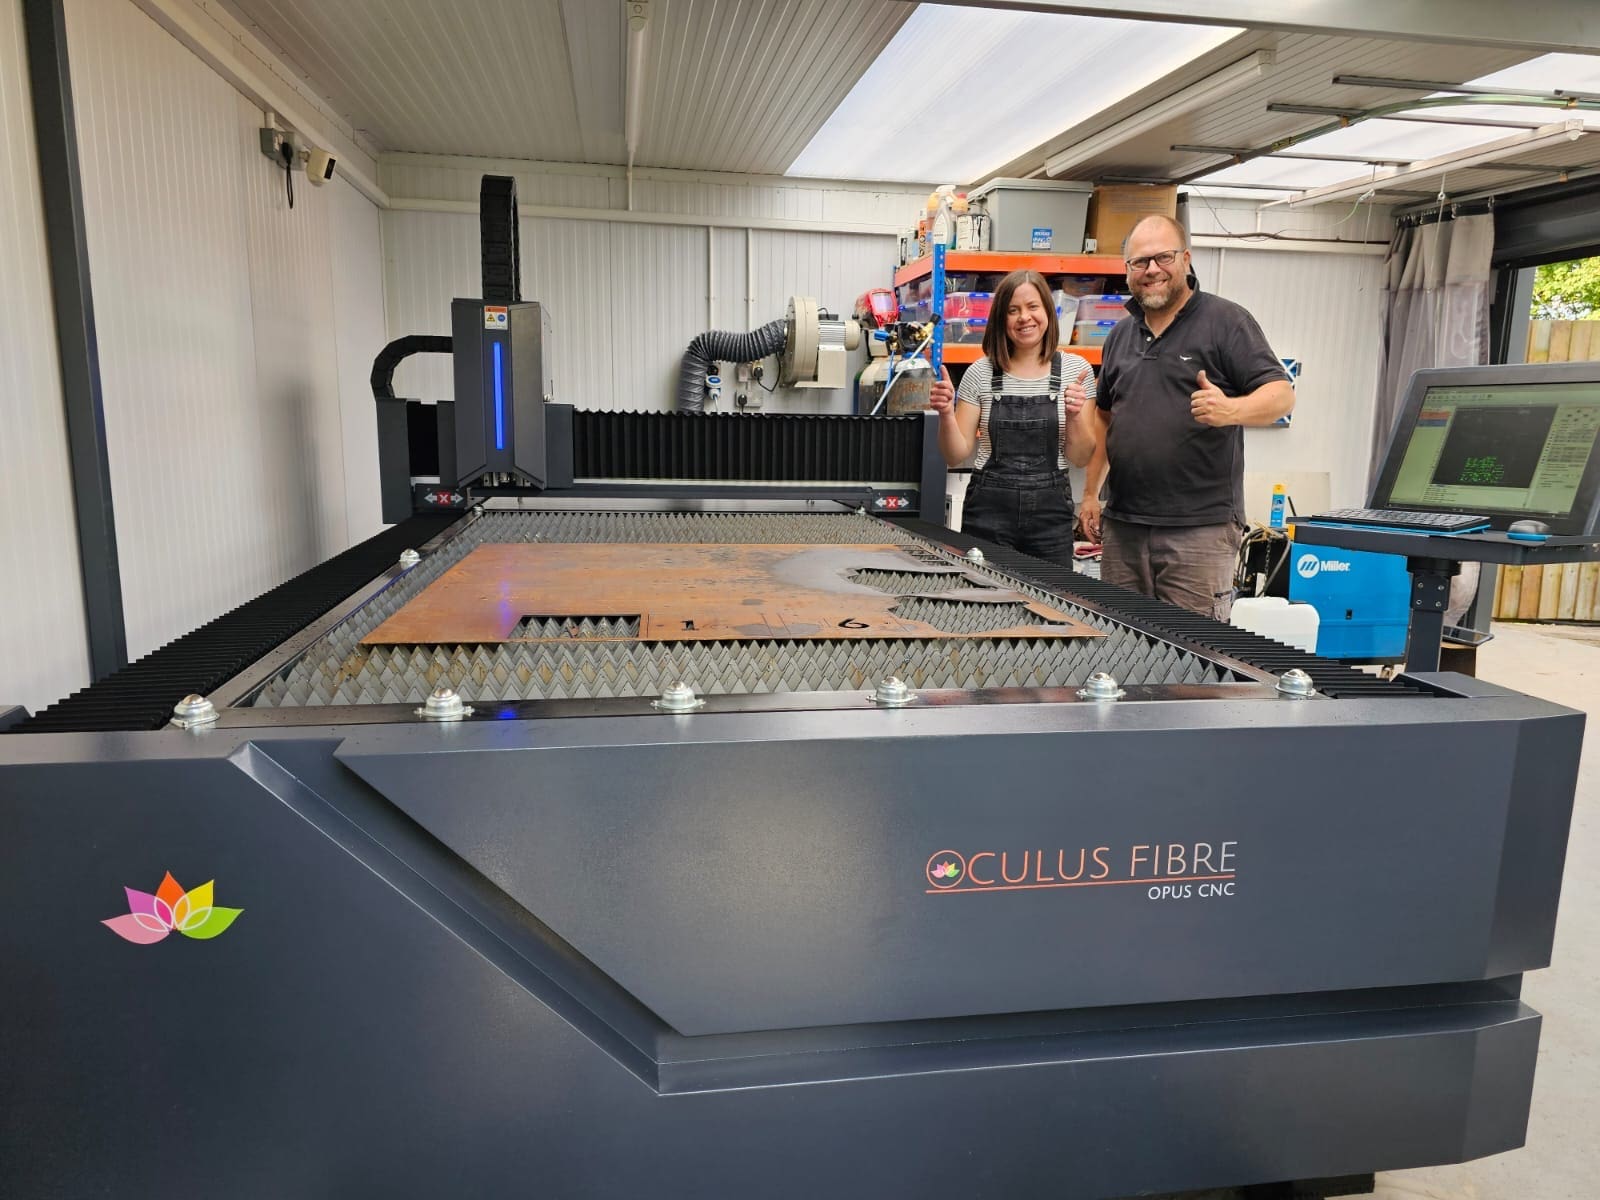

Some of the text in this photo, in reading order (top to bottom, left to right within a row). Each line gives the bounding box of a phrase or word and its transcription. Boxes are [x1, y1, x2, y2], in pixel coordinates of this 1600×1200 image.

[439, 494, 449, 503] X
[888, 498, 896, 507] X
[1320, 560, 1351, 572] Miller
[926, 841, 1237, 889] OCULUS FIBRE
[1147, 882, 1236, 901] OPUS CNC
